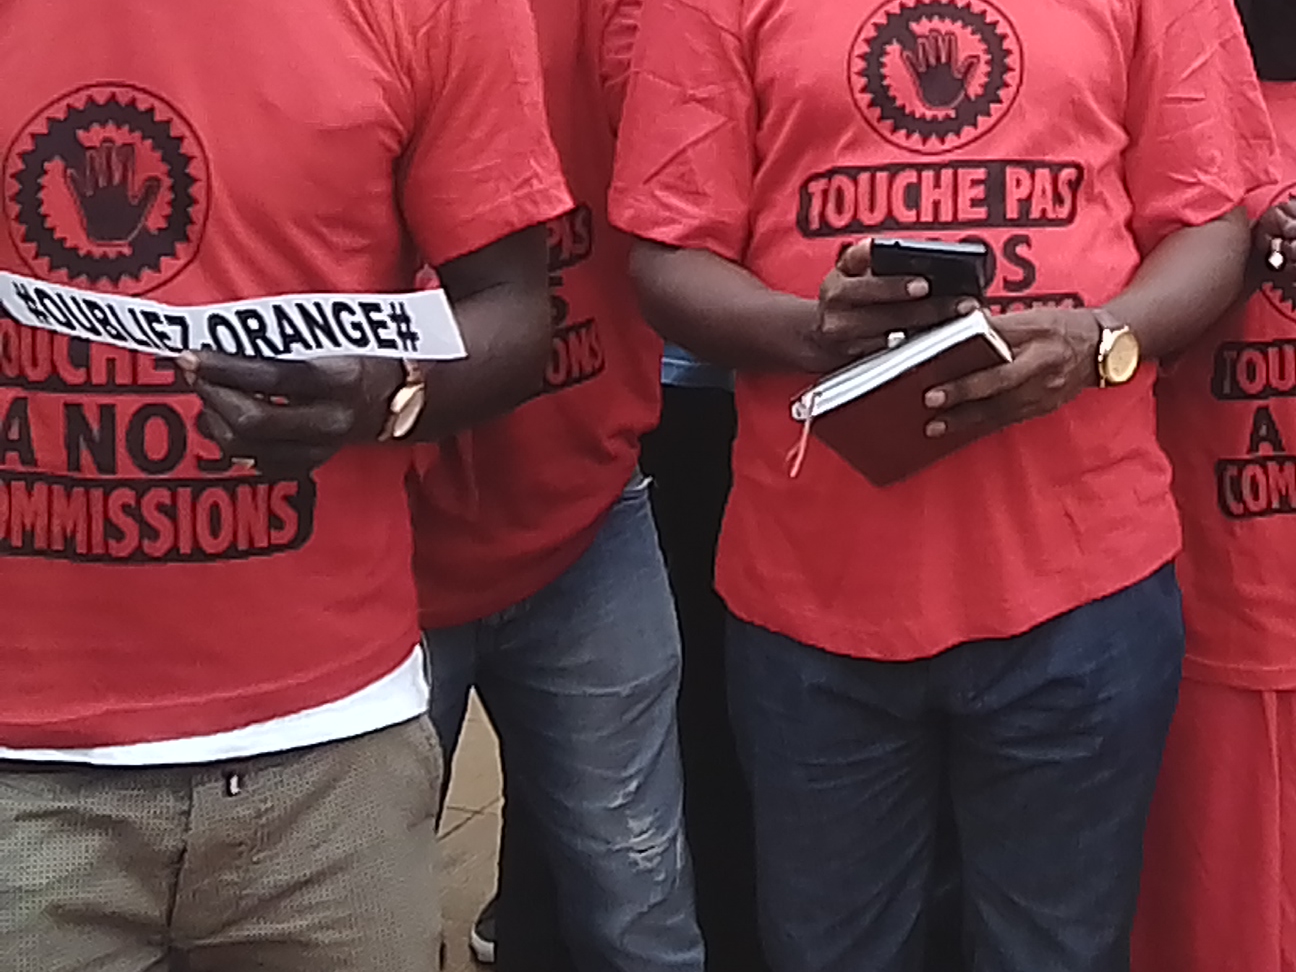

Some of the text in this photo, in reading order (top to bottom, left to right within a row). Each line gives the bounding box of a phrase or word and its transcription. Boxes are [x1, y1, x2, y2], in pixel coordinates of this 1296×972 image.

[807, 165, 1080, 230] TOUCHE PAS
[1250, 406, 1286, 454] A
